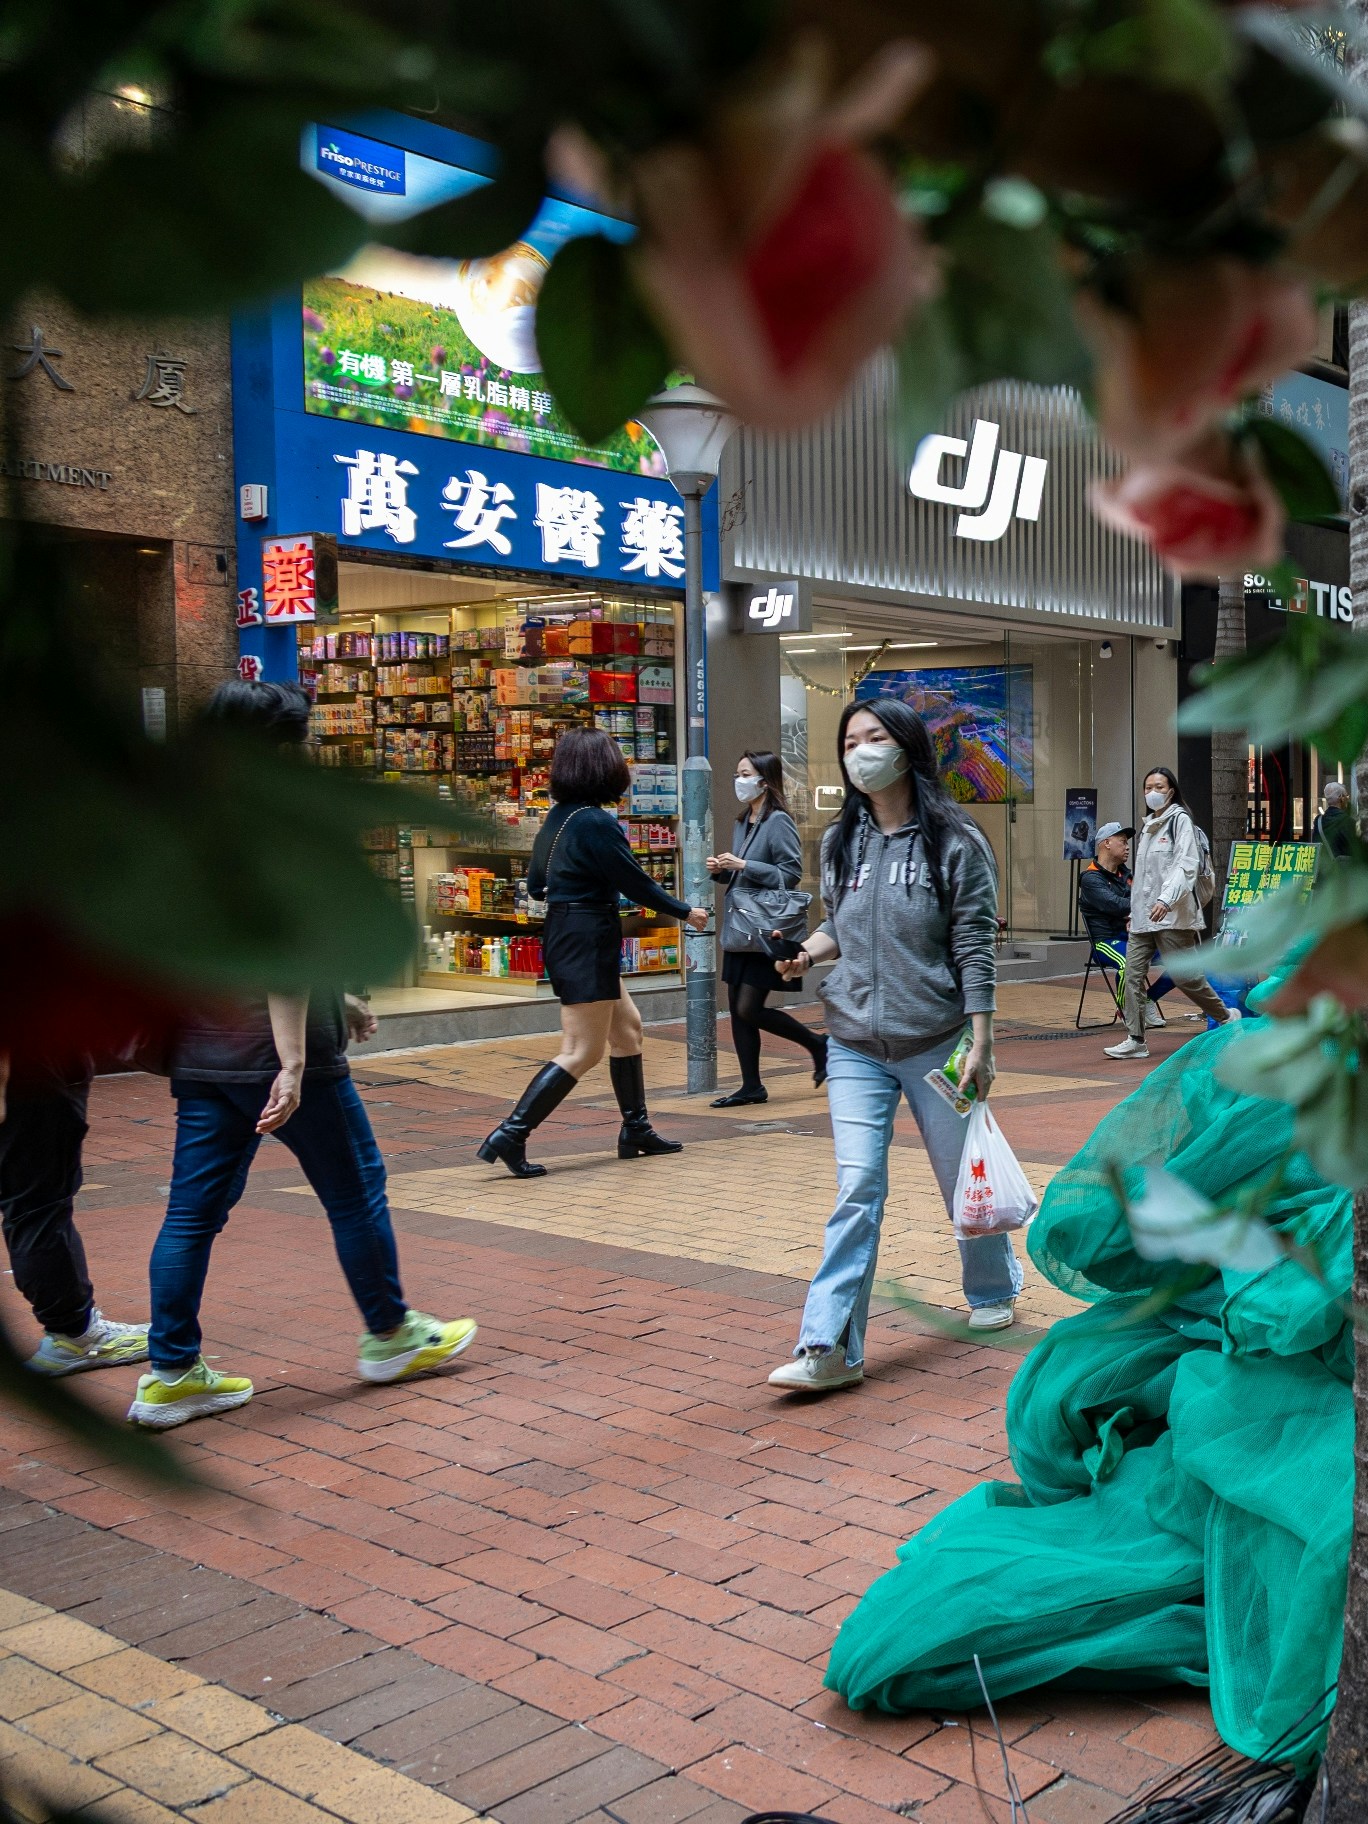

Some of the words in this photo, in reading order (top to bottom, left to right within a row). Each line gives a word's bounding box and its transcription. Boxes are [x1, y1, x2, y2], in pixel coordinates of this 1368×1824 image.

[337, 349, 387, 382] 有機
[332, 449, 686, 579] 萬安醫藥
